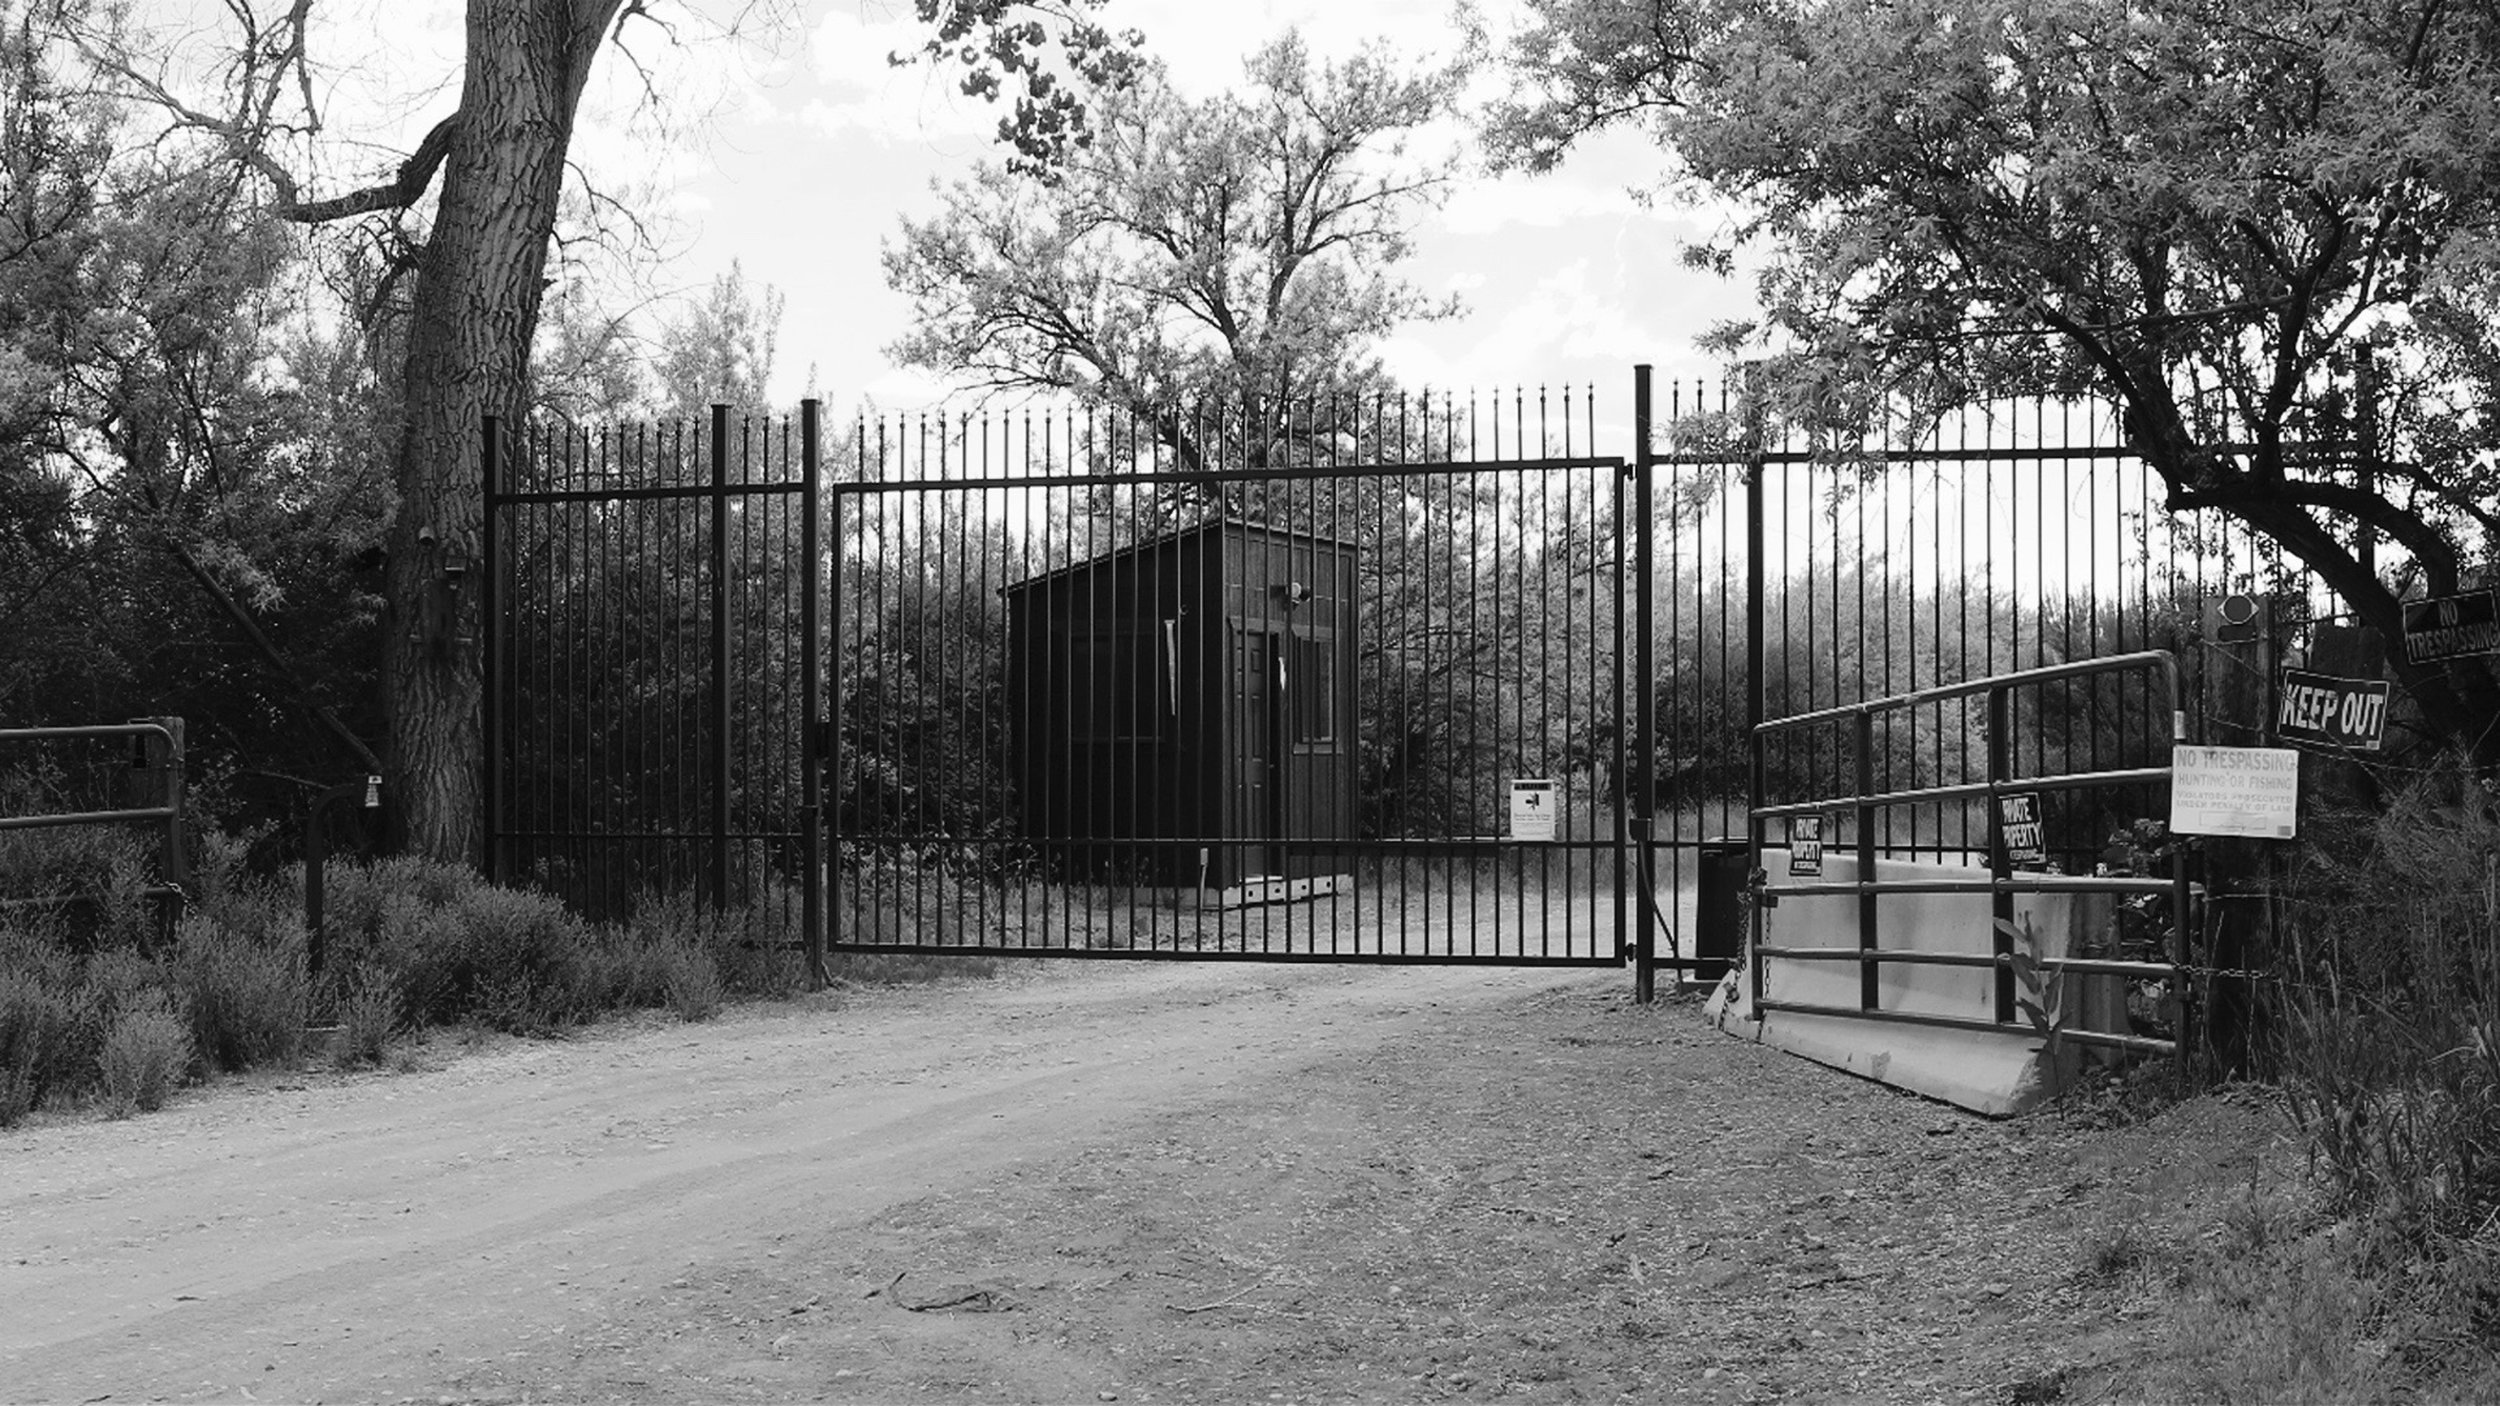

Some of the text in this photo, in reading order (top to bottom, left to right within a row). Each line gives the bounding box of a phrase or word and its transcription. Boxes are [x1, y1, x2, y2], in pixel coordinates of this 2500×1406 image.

[2438, 600, 2458, 626] NO
[2408, 622, 2500, 658] TRESPASSING
[2282, 684, 2384, 736] KEEP OUT
[2177, 750, 2295, 771] NO TRESPASSING
[2178, 774, 2293, 790] HUNTING OR FISHING
